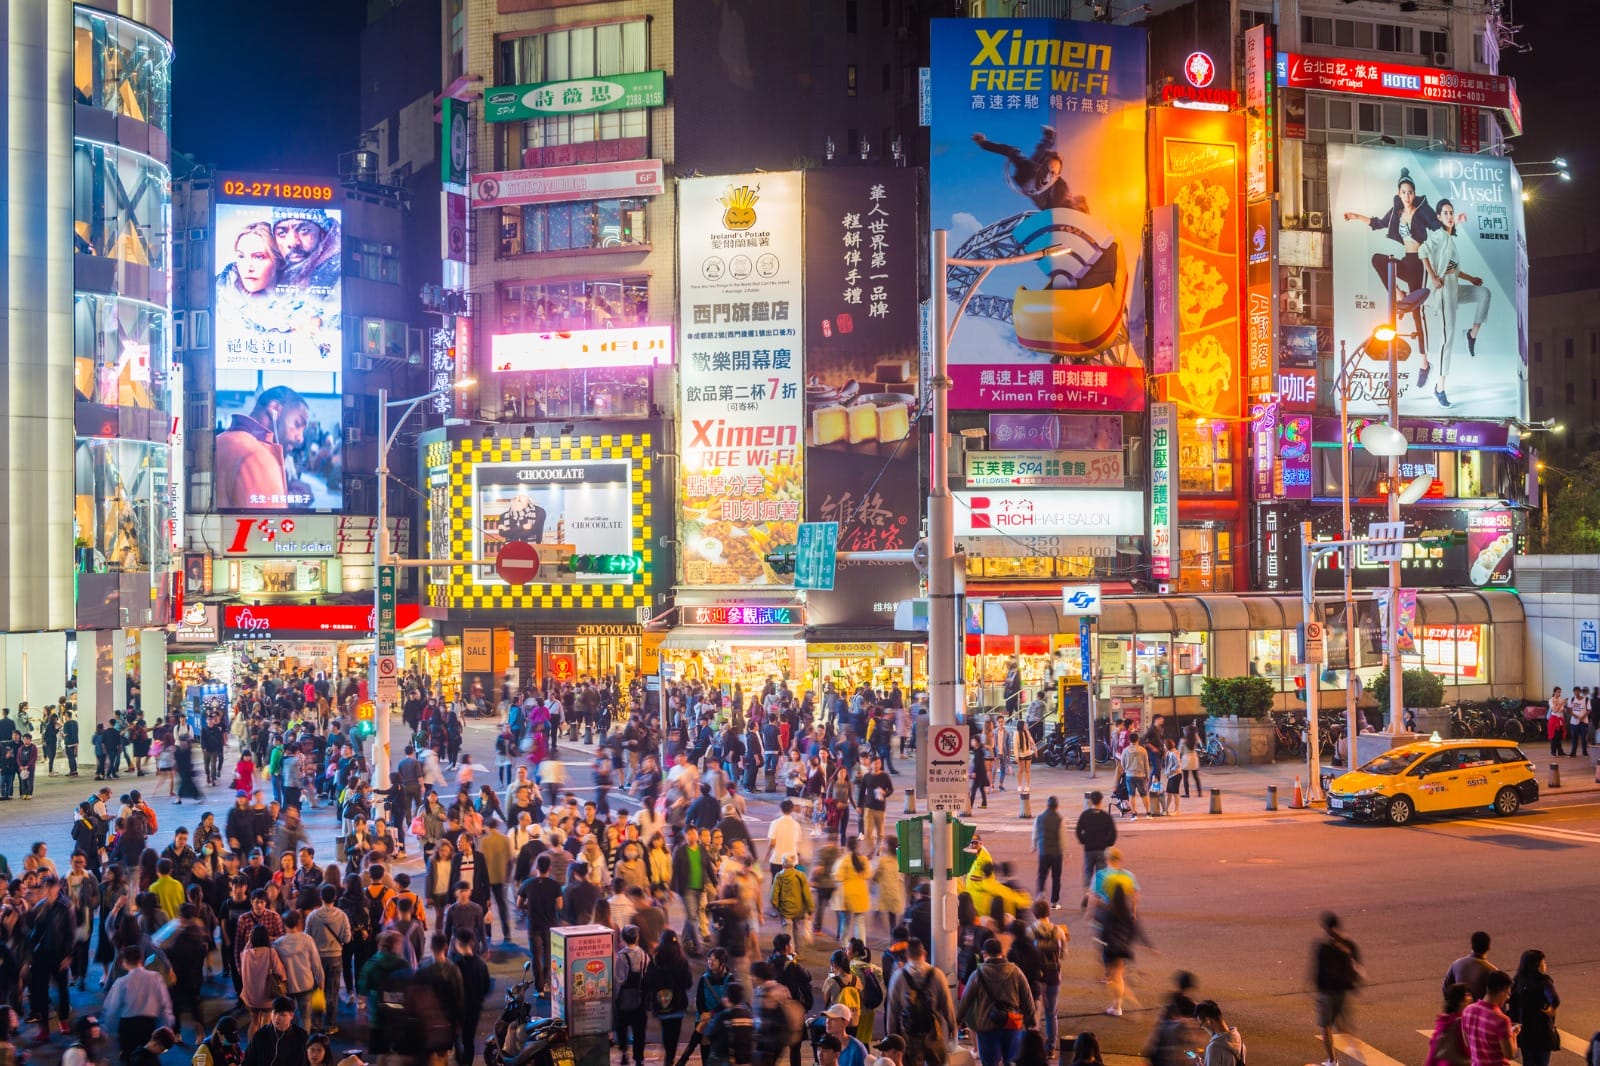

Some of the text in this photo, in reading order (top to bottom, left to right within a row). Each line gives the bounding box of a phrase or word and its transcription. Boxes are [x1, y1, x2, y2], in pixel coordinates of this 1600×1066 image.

[970, 29, 1112, 71] Ximen
[970, 69, 1109, 95] FREE Wi-Fi
[1383, 73, 1419, 90] HOTEL
[971, 94, 1039, 110] 高速奔馳
[1448, 160, 1504, 182] Define
[224, 181, 332, 200] 02-27182099
[1449, 180, 1505, 207] Myself
[868, 184, 890, 319] 華人世界第一品牌
[693, 300, 789, 324] 西門旗鑑店
[692, 349, 791, 371] 歡樂開幕慶
[1052, 370, 1108, 388] 即刻選擇
[992, 390, 1033, 402] Ximen
[1038, 390, 1064, 402] Free
[1067, 391, 1098, 402] Wi-Fi
[689, 419, 797, 448] Ximen
[694, 449, 795, 467] REE Wi-Fi
[971, 461, 1015, 476] 玉芙蓉
[1017, 462, 1043, 475] SPA
[687, 475, 764, 497] 點擊分享
[720, 499, 799, 521] 即刻瘋薯
[997, 513, 1110, 526] RICH HAIR SALON
[275, 541, 333, 552] hair salon
[1268, 580, 1278, 589] 2F
[467, 646, 487, 656] SALE
